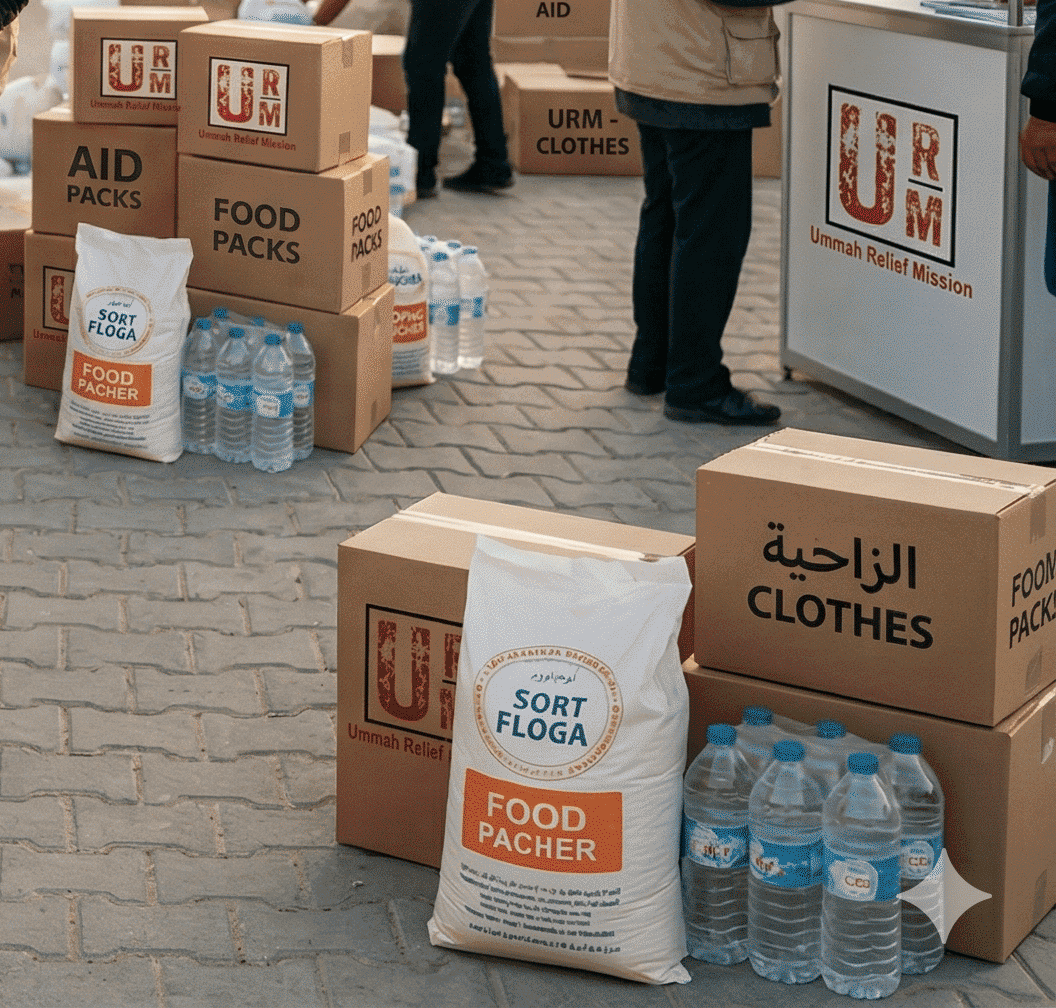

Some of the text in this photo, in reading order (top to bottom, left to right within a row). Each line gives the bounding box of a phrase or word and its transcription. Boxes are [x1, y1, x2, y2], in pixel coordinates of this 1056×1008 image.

[536, 1, 571, 18] AID
[108, 43, 171, 94] URM
[217, 64, 281, 128] URM
[548, 108, 603, 129] URM
[67, 145, 143, 183] AID
[536, 137, 630, 156] CLOTHES
[838, 102, 943, 248] URM
[67, 184, 142, 209] PACKS
[214, 197, 301, 233] FOOD
[352, 205, 382, 236] FOOD
[213, 229, 301, 264] PACKS
[351, 228, 382, 263] PACKS
[810, 224, 973, 299] Ummah Relief Mission
[87, 320, 137, 342] FLOGA
[97, 308, 137, 326] SORT
[78, 378, 139, 401] PACHER
[83, 362, 134, 386] FOOD
[762, 521, 916, 594] الزاحية
[747, 585, 934, 650] CLOTHES
[512, 688, 588, 718] SORT
[347, 722, 400, 750] Ummah
[403, 736, 445, 762] Relief
[495, 710, 588, 747] FLOGA
[487, 791, 587, 832] FOOD
[478, 820, 597, 862] PACHER
